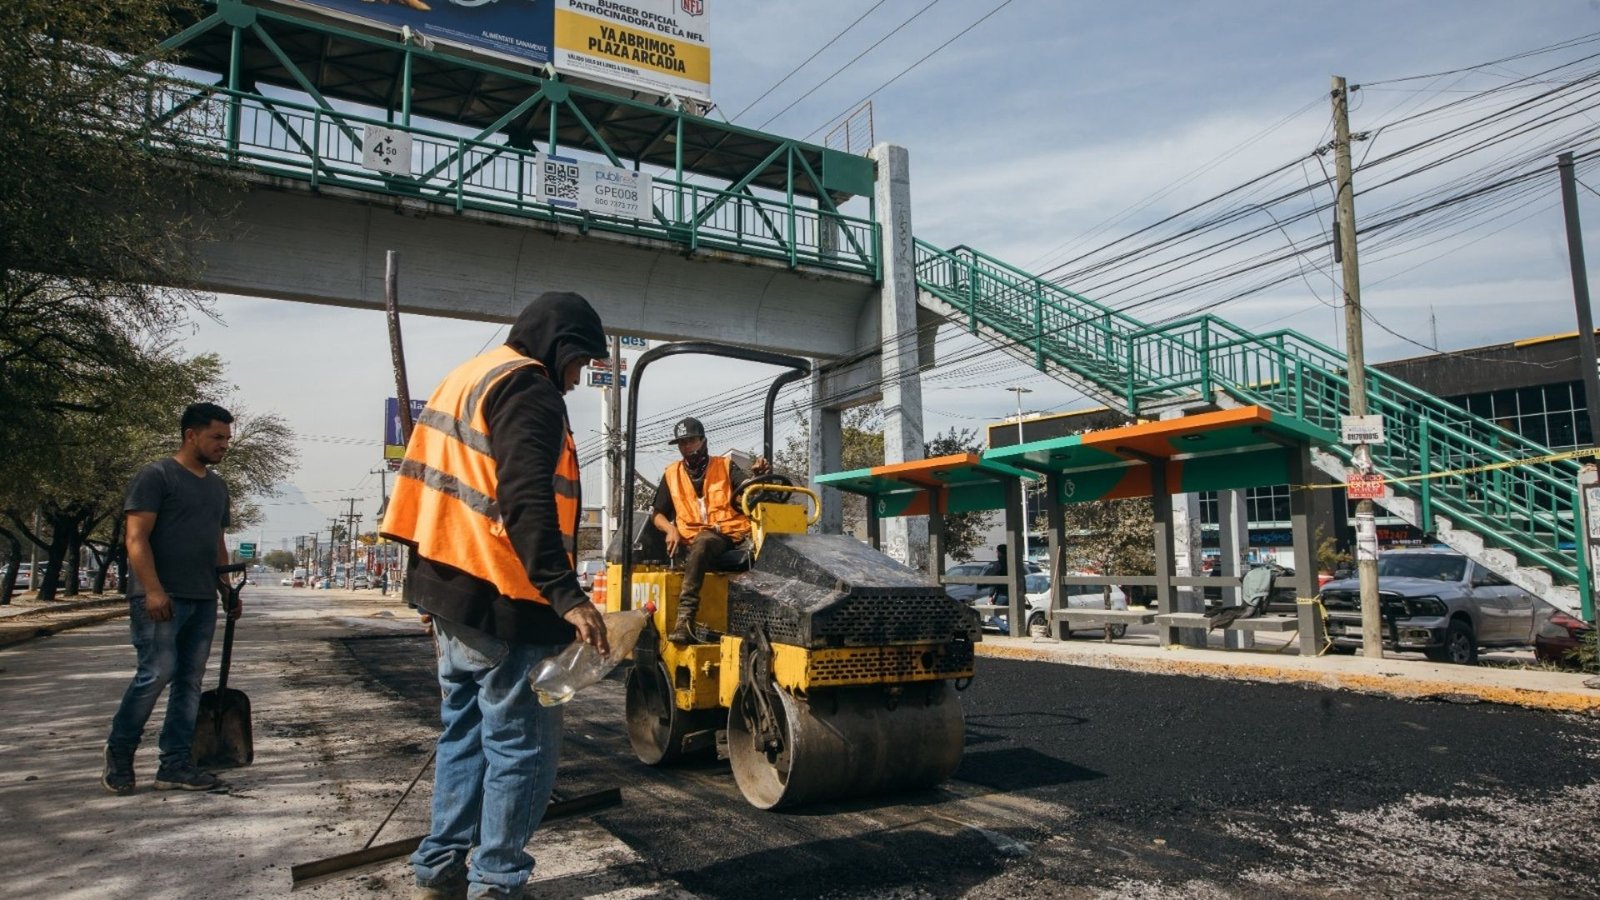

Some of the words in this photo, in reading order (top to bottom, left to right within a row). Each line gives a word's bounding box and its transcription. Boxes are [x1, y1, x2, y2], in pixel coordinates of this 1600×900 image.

[569, 0, 655, 29] PATROCINADORA
[657, 23, 670, 34] DE
[673, 27, 684, 37] LA
[686, 31, 704, 42] NFL
[598, 0, 639, 17] BURGER
[641, 11, 678, 27] OFICIAL
[682, 0, 702, 14] NFL
[588, 37, 630, 59] PLAZA
[632, 48, 686, 73] ARCADIA
[600, 25, 616, 40] YA
[619, 30, 675, 57] ABRIMOS
[595, 184, 639, 202] GPE008
